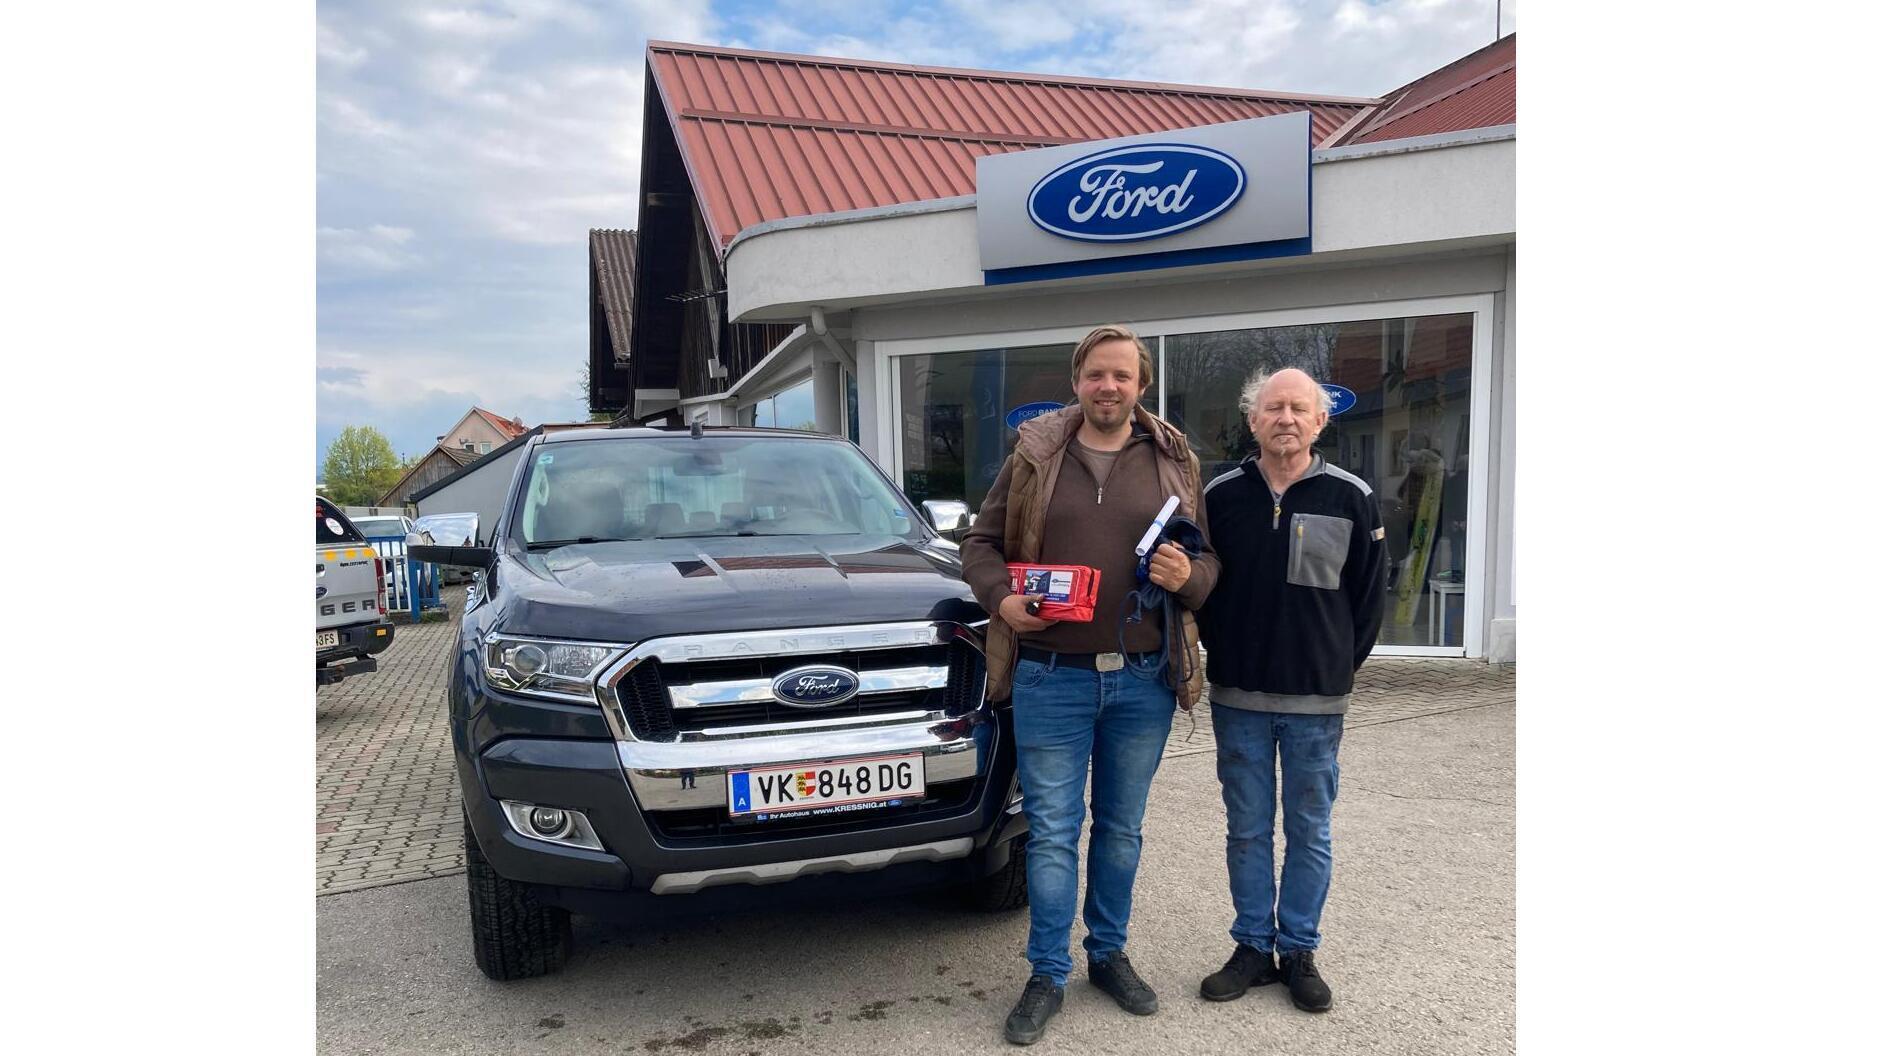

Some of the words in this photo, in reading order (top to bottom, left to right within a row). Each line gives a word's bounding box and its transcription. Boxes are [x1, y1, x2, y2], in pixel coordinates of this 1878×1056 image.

[1067, 160, 1198, 223] Ford
[320, 599, 376, 616] GER
[684, 630, 934, 656] RANGER
[795, 674, 841, 697] Ford
[758, 773, 795, 805] VK
[818, 765, 872, 798] 848
[878, 761, 912, 793] DG
[738, 798, 746, 807] A
[779, 810, 810, 819] Autohaus
[813, 801, 887, 815] www.KRESSNIG.at
